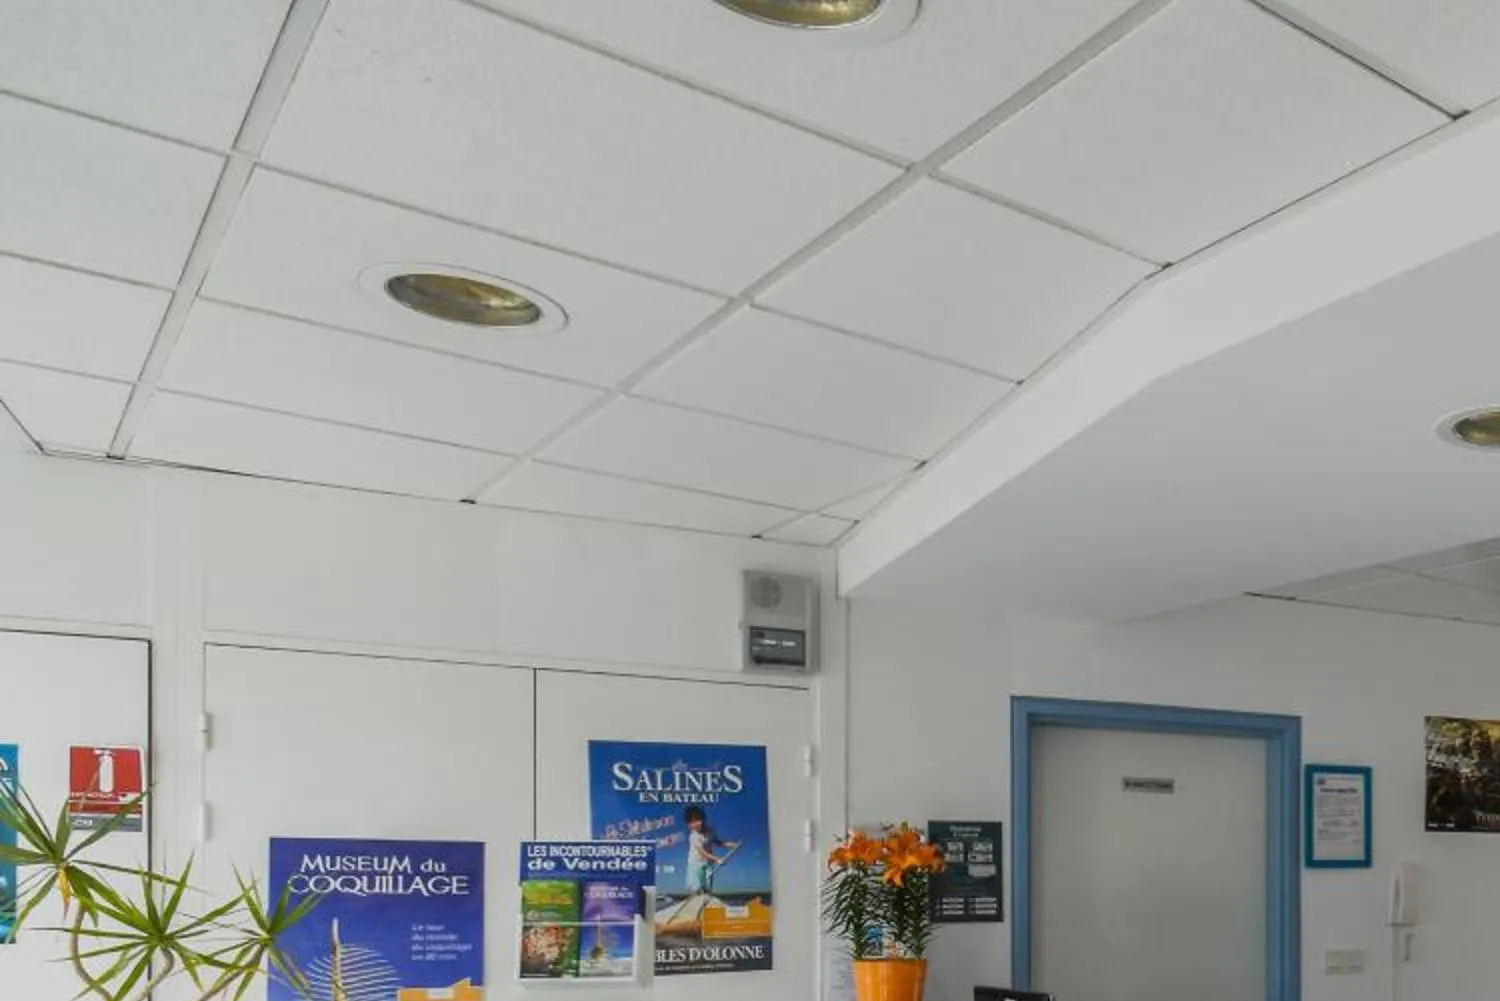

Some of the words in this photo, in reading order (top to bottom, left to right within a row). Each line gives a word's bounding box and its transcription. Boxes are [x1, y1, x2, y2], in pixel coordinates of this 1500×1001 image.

[612, 761, 743, 793] SALINES
[639, 790, 659, 803] EN
[662, 791, 720, 804] BATEAU
[527, 845, 548, 858] LES
[300, 854, 413, 875] MUSEUM
[419, 858, 447, 873] du
[527, 858, 556, 871] de
[562, 857, 648, 871] Vendée
[287, 874, 470, 897] COQUILLAGE
[688, 945, 766, 962] D'OLONNE
